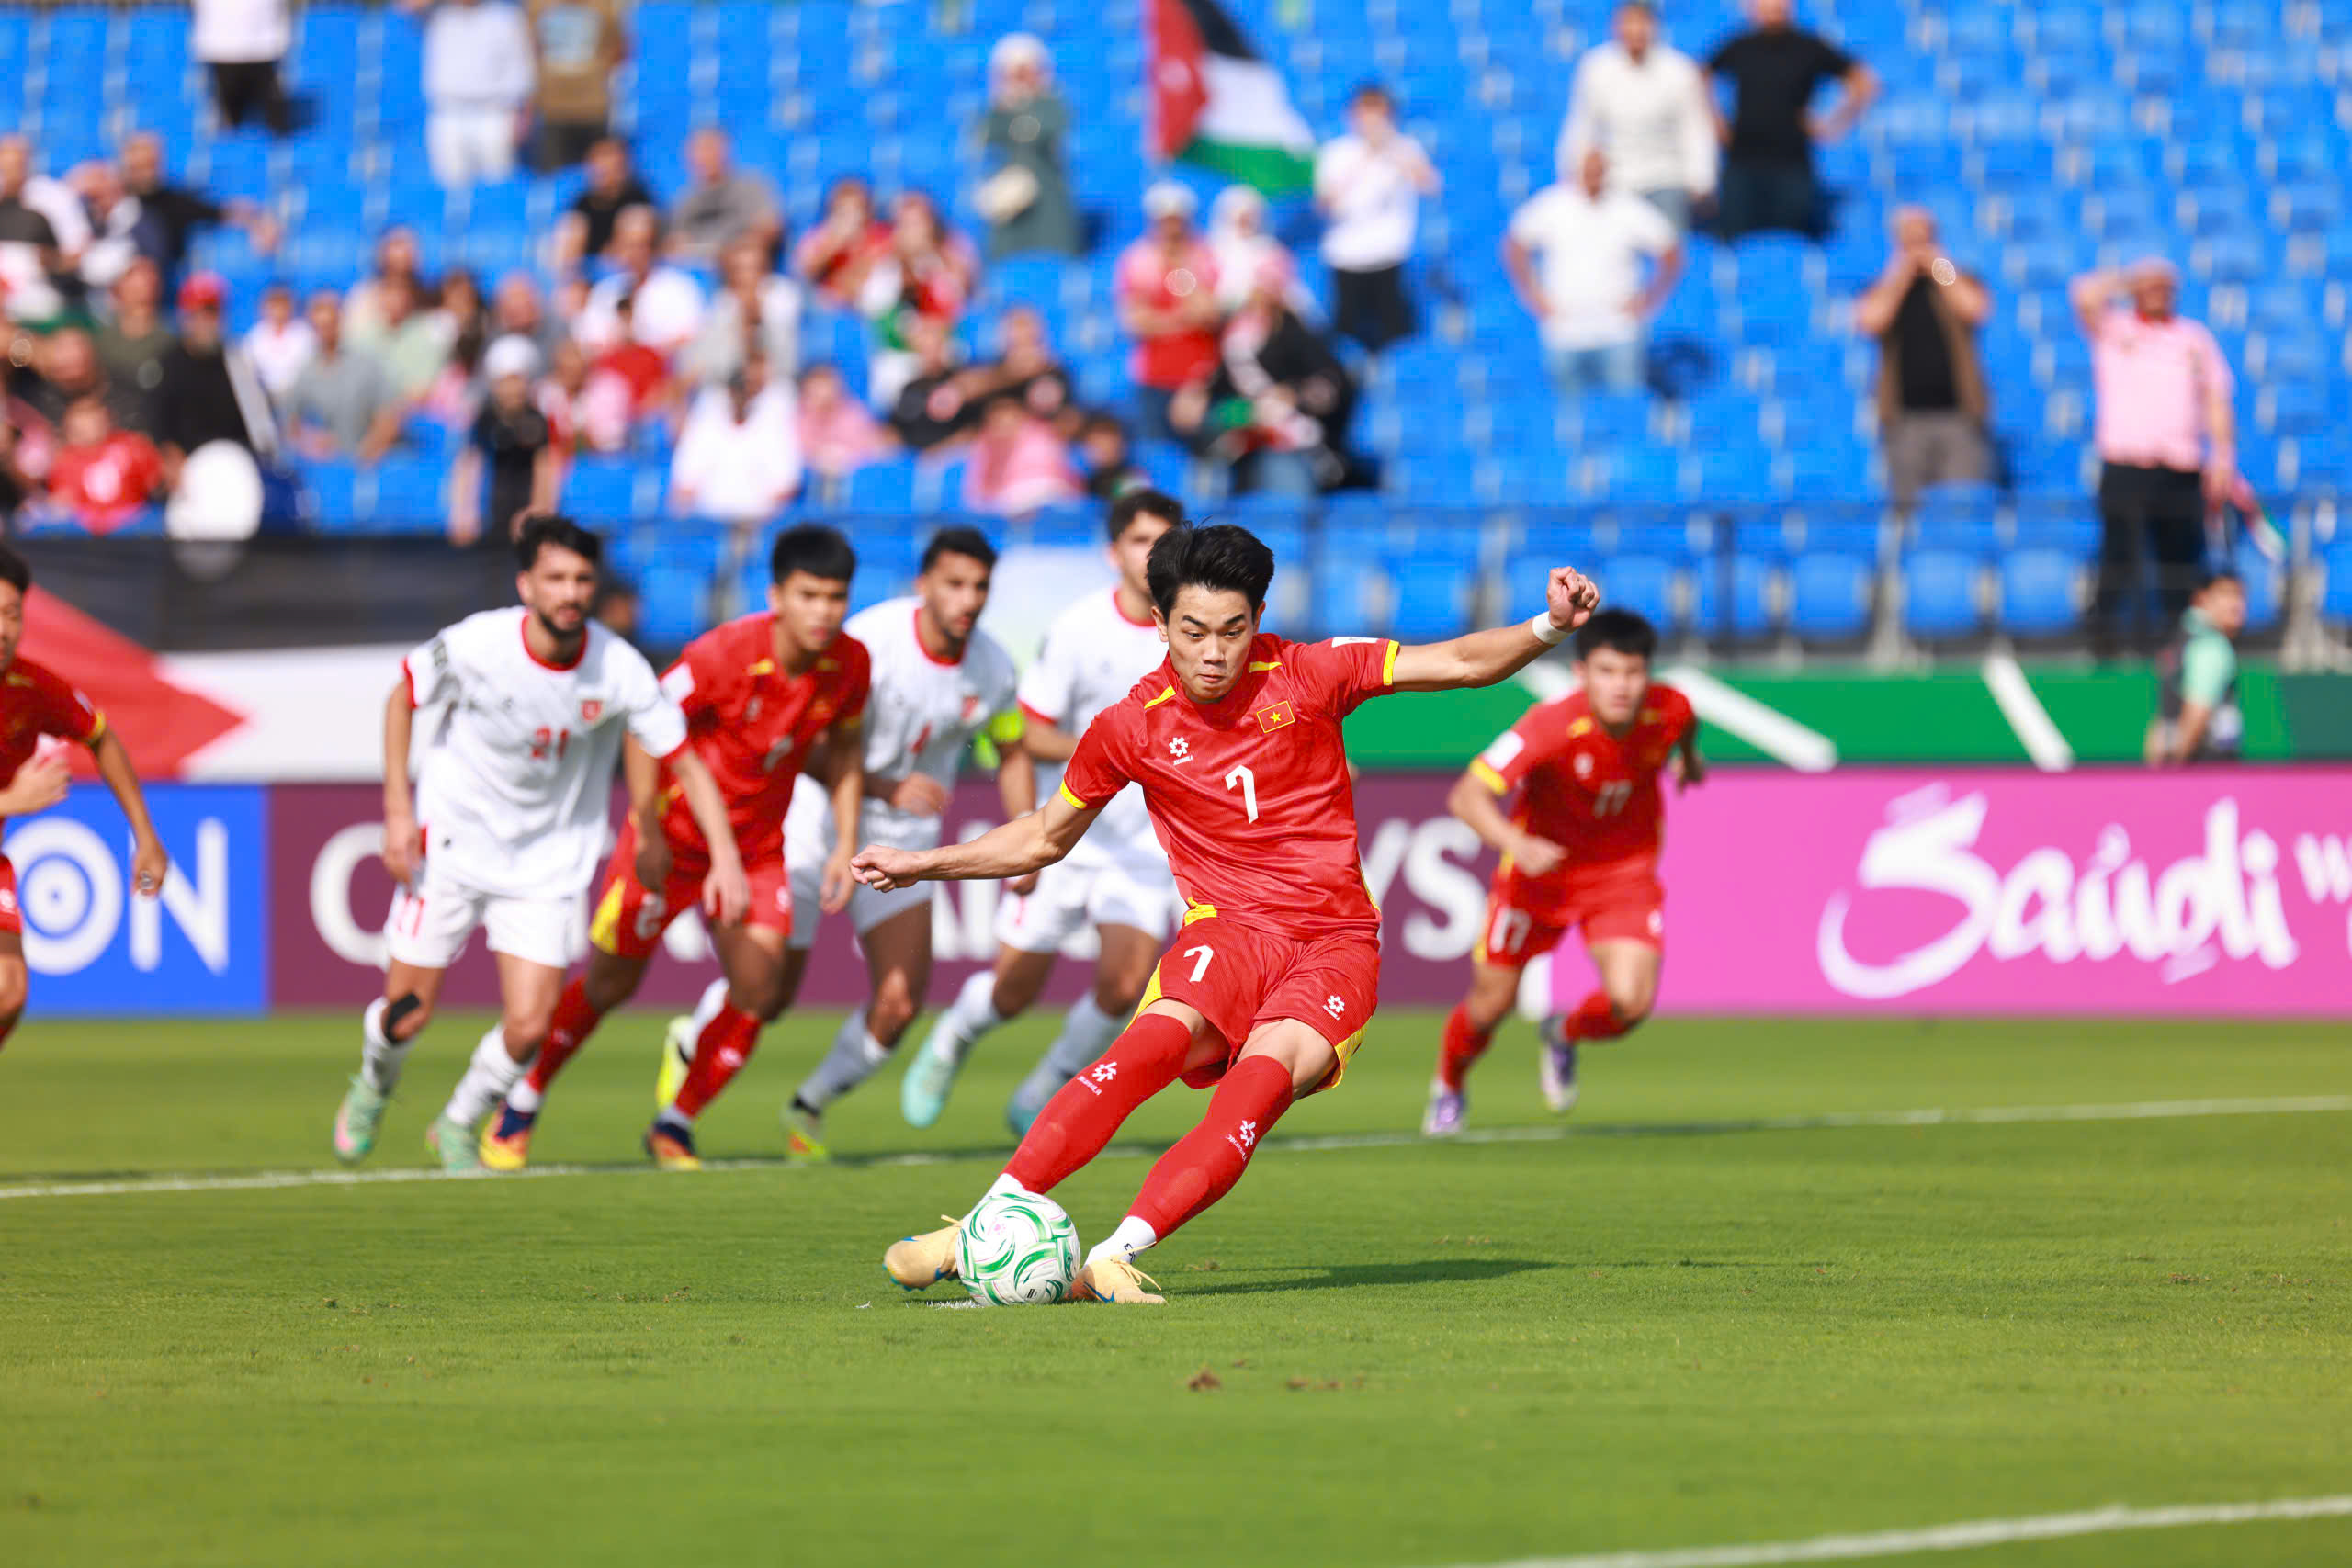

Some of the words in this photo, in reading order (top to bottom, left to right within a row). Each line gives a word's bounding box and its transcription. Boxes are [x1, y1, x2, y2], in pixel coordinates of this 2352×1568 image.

[1225, 764, 1259, 824] 7
[1815, 781, 2299, 1000] Saudi
[1182, 944, 1215, 983] 7
